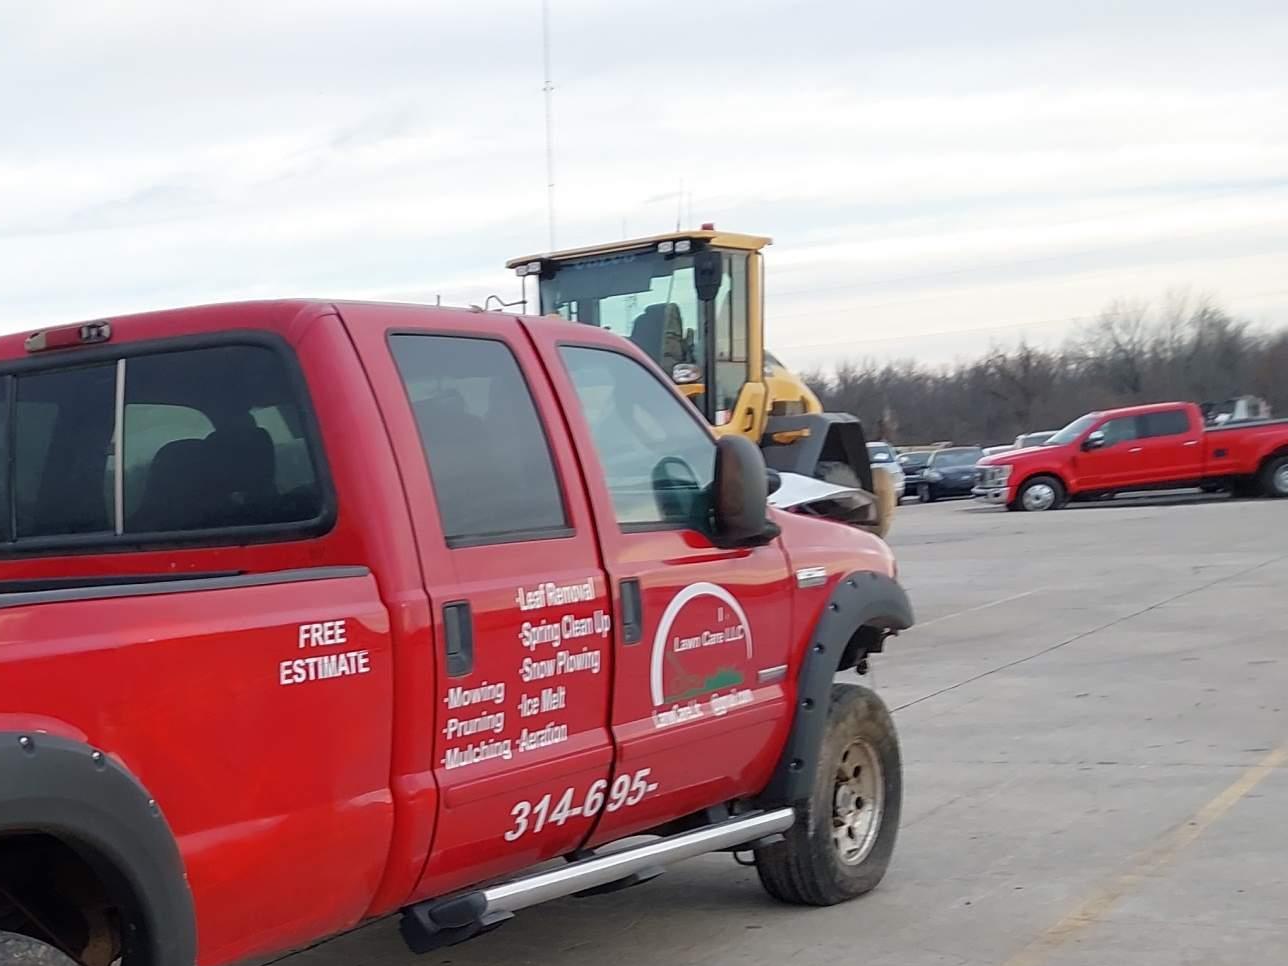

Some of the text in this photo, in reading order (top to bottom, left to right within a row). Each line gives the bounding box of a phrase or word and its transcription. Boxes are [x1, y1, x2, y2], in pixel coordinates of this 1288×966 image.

[546, 577, 595, 607] Removal
[298, 620, 347, 648] FREE
[561, 614, 594, 639] Clean
[593, 610, 611, 638] Up
[674, 636, 701, 652] Lawn
[702, 631, 724, 647] Care
[279, 650, 370, 685] ESTIMATE
[556, 647, 601, 673] Plowing
[540, 686, 566, 712] Melt
[504, 768, 659, 841] 314-695-
